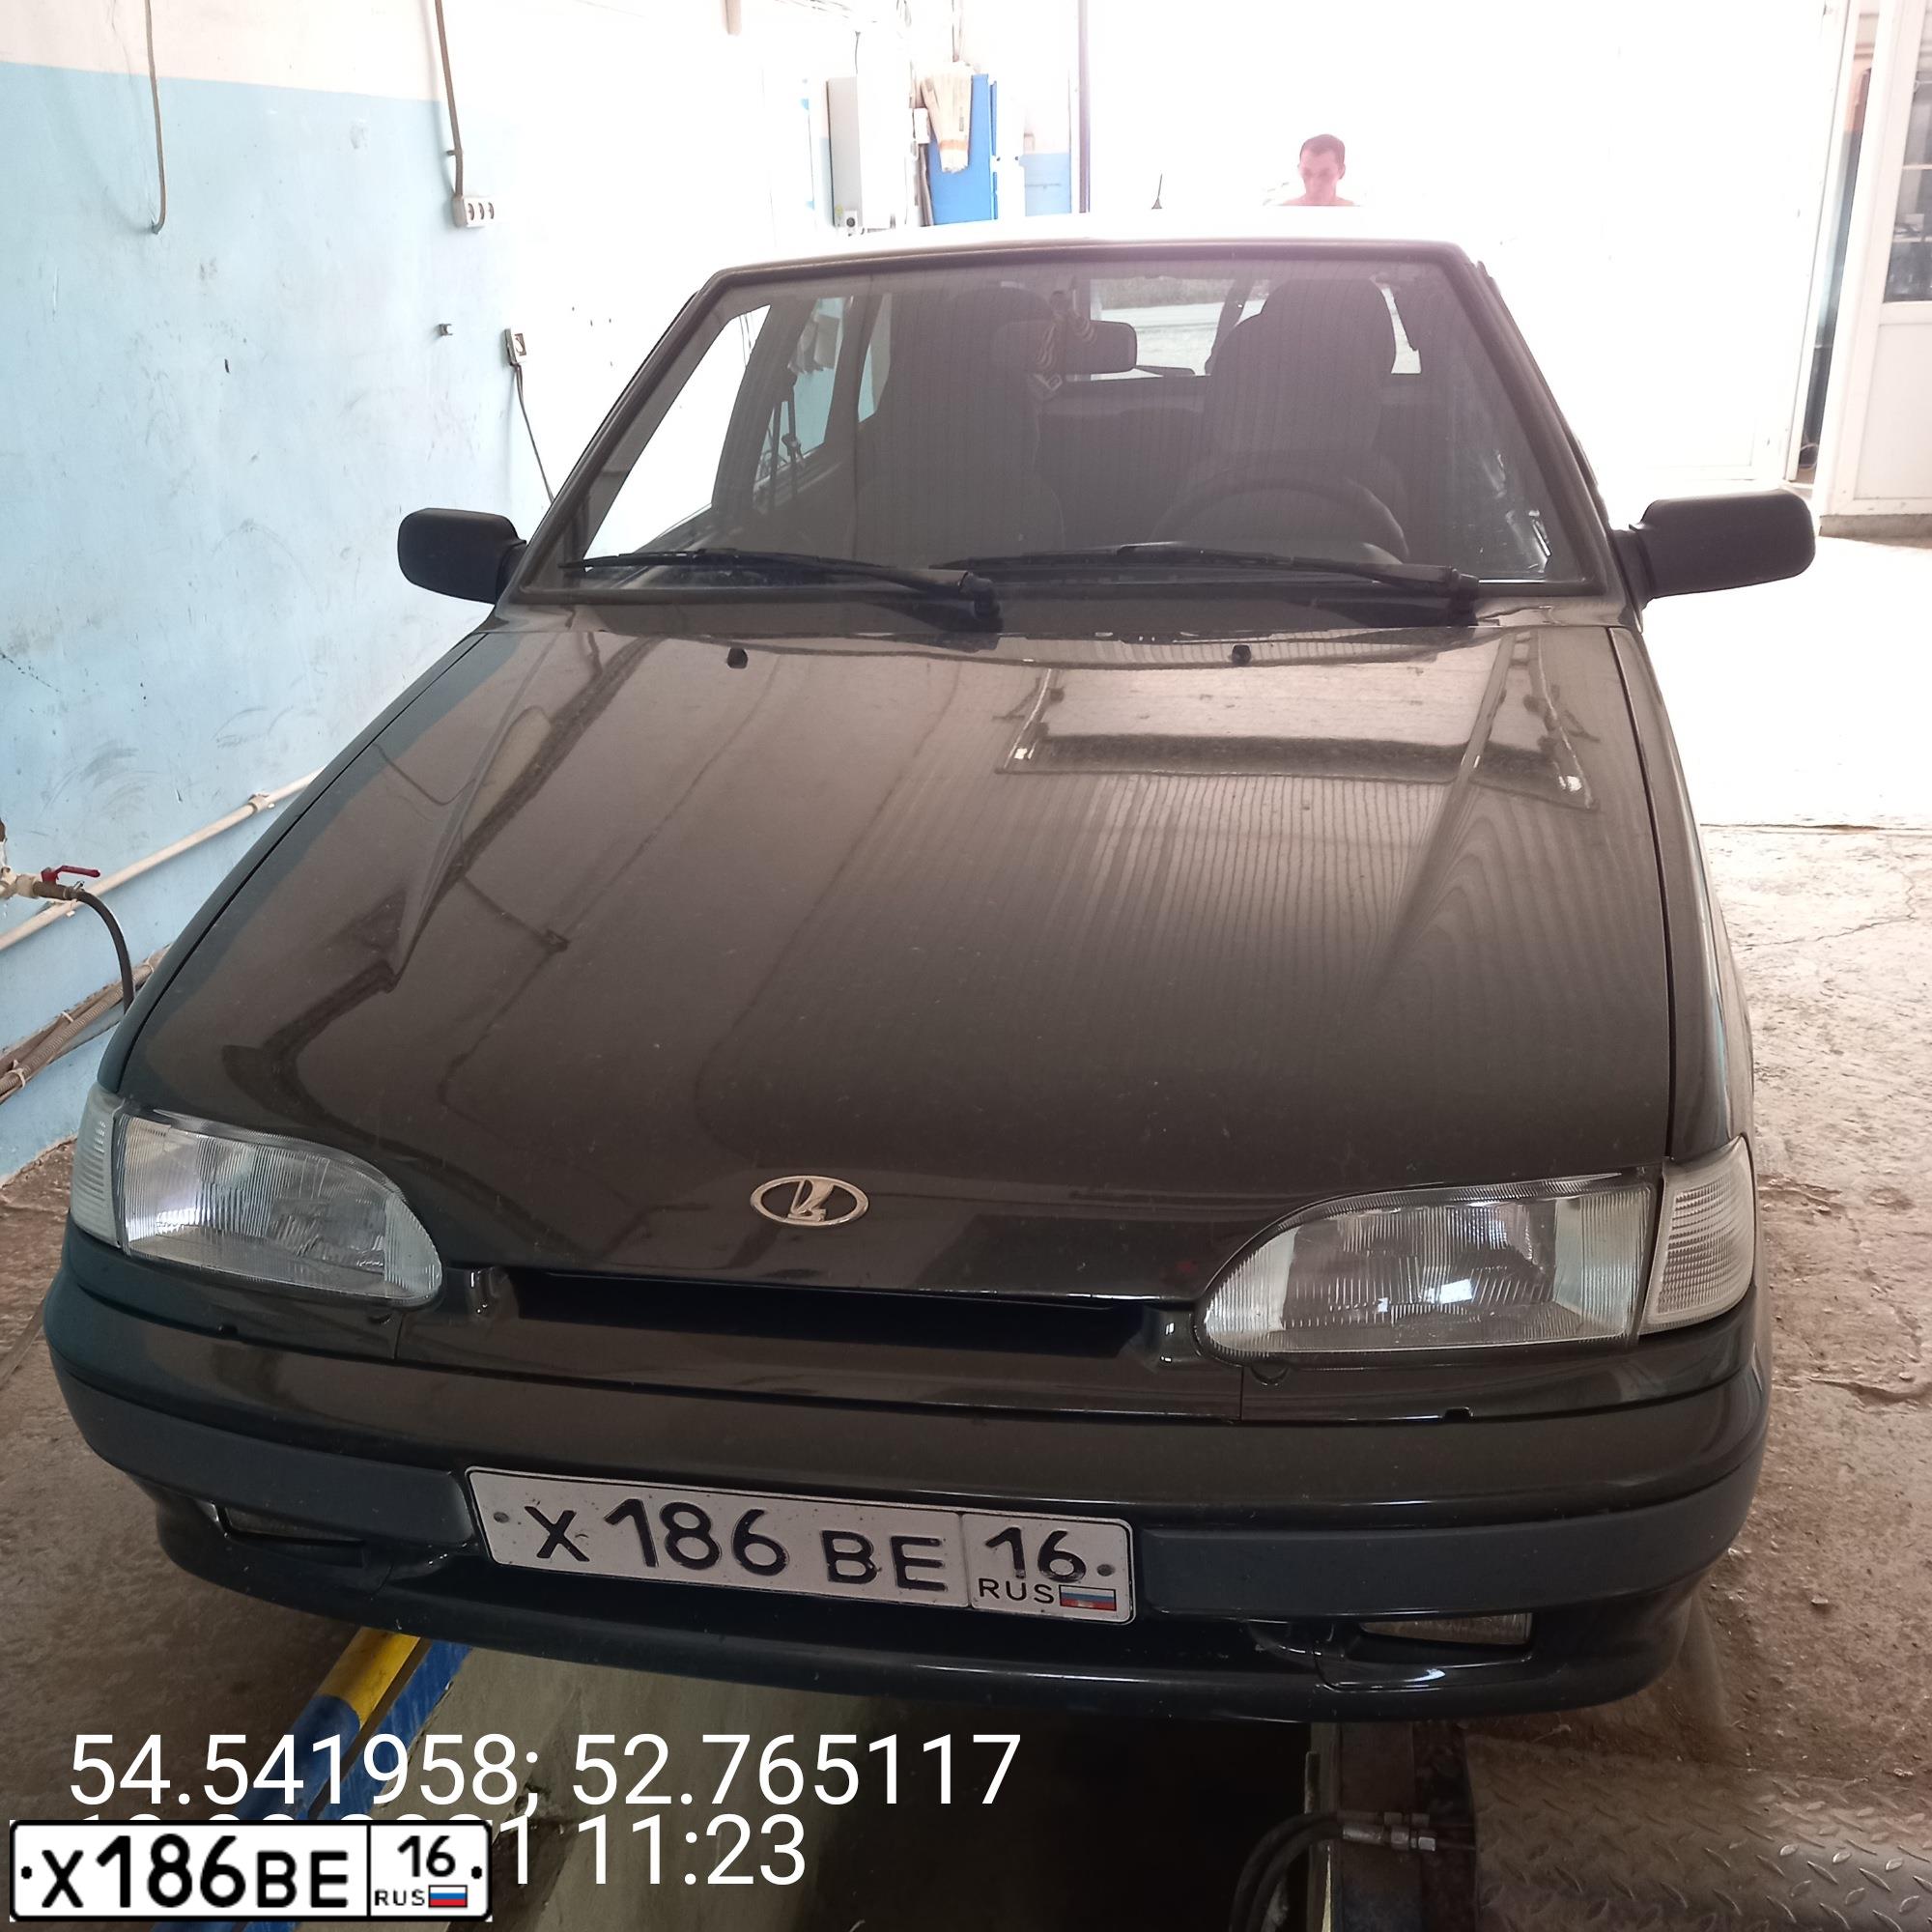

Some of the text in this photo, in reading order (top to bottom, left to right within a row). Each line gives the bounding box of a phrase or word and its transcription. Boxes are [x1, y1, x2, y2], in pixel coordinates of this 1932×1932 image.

[603, 1498, 789, 1577] 186
[984, 1526, 1087, 1583] 16
[978, 1577, 1055, 1604] RUS
